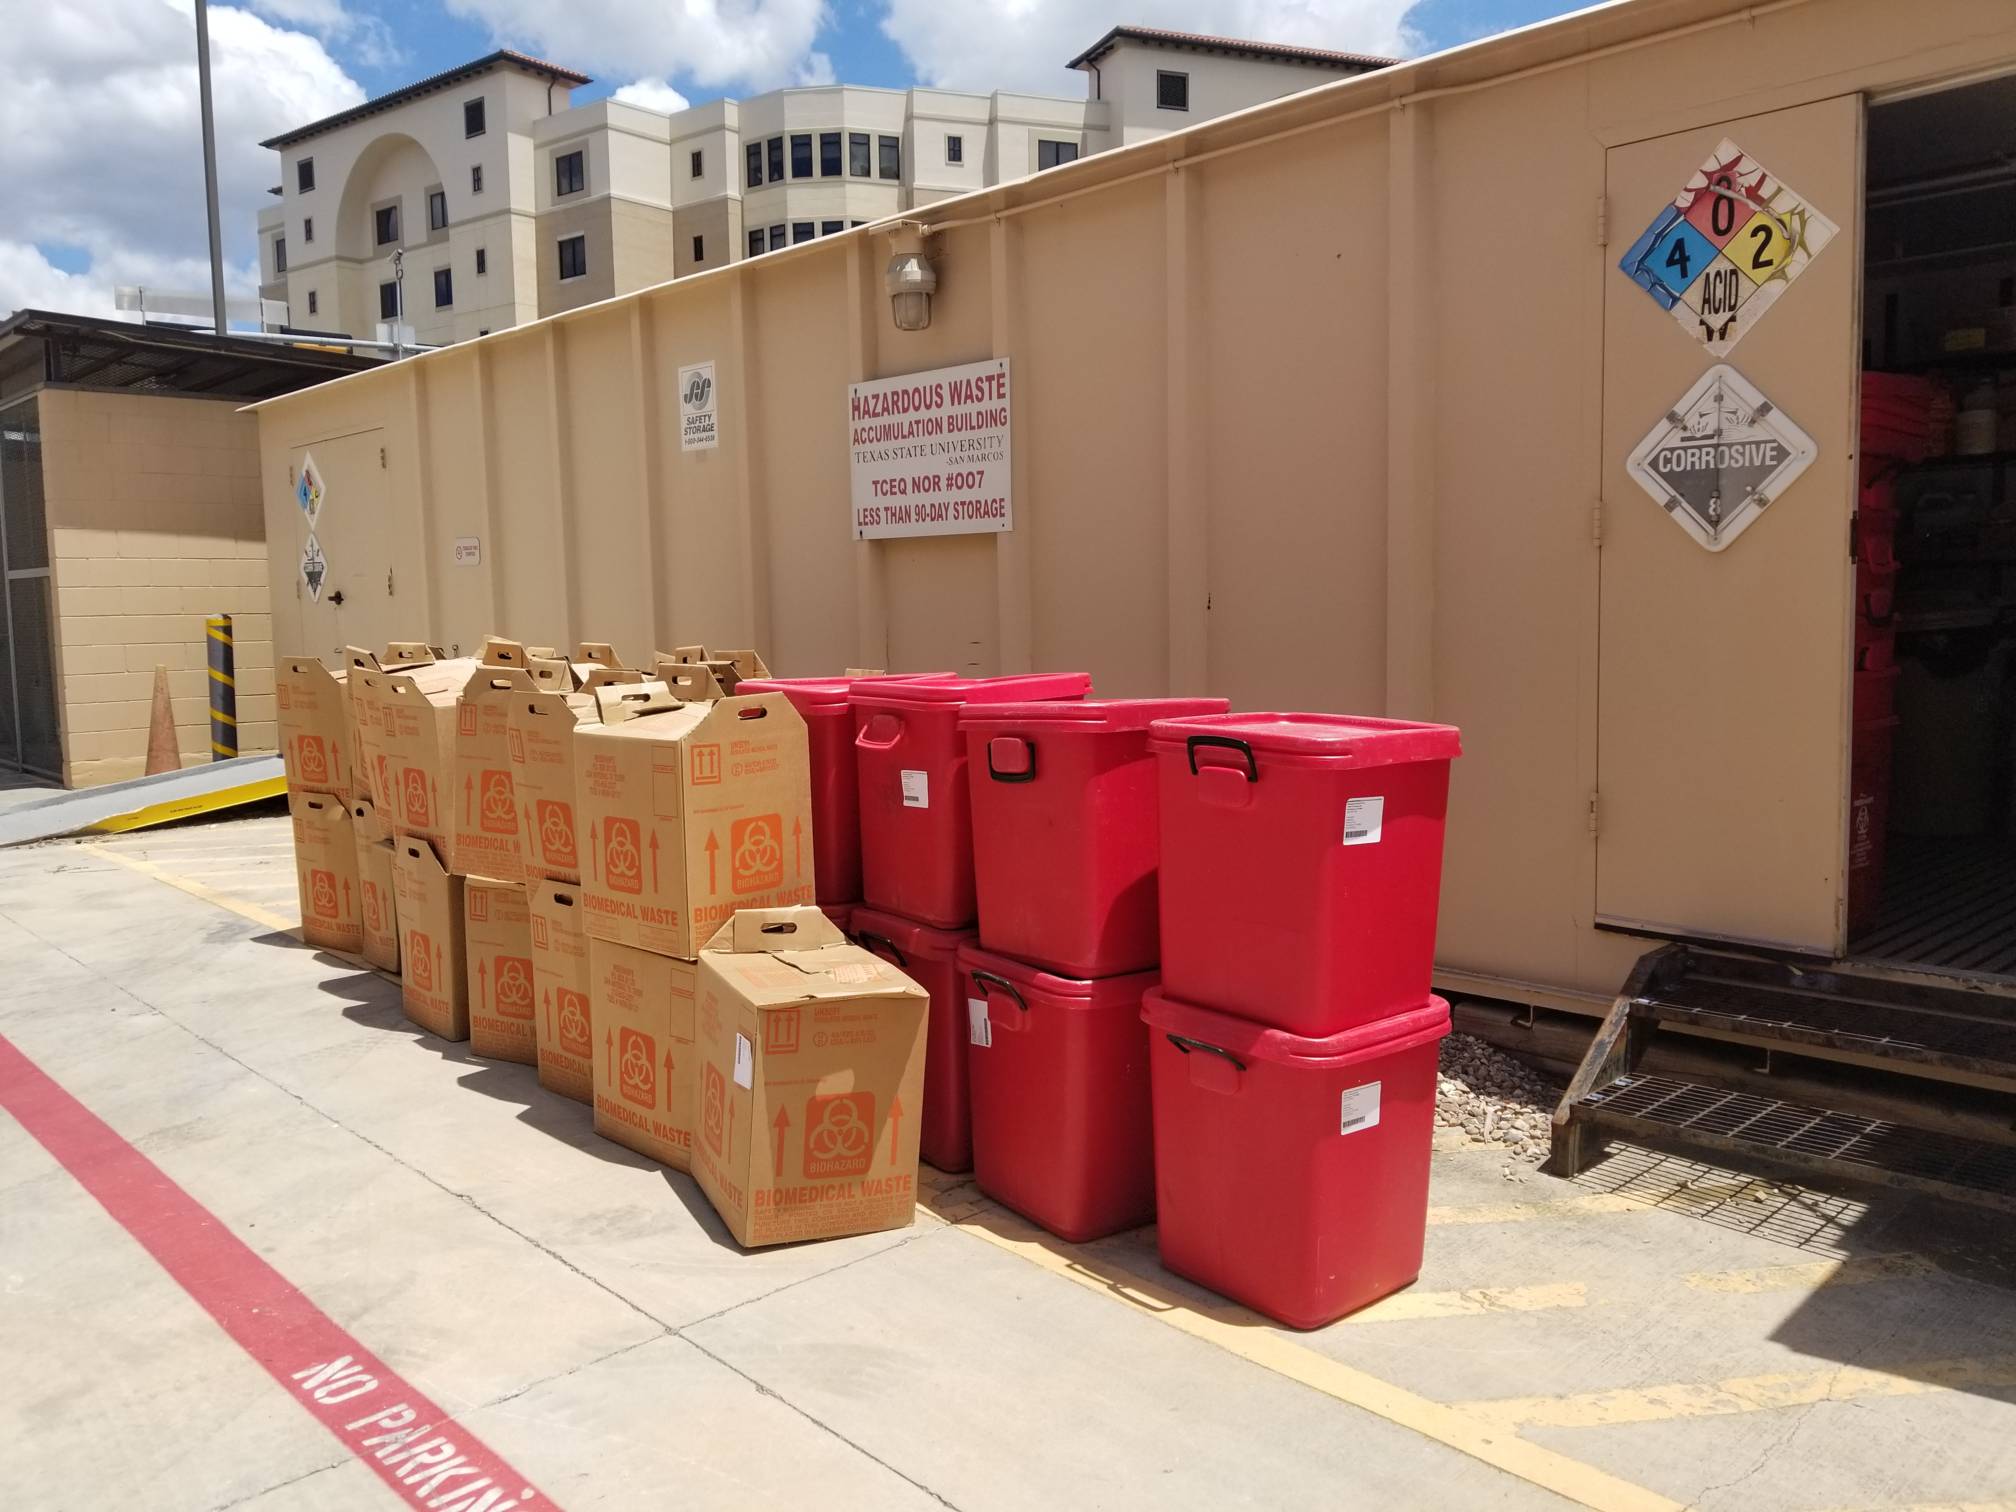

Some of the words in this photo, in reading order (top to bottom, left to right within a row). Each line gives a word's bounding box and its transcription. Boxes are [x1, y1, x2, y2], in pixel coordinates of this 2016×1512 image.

[1666, 237, 1691, 279] 4
[1750, 224, 1774, 270] 2
[1701, 268, 1740, 316] ACID
[851, 382, 944, 421] HAZARDOUS
[948, 372, 1007, 407] WASTE
[684, 422, 715, 436] STORAGE
[686, 413, 713, 426] SAFETY
[852, 416, 943, 446] ACCUMULATION
[947, 406, 1008, 434] BUILDING
[855, 449, 891, 464] TEXAS
[892, 444, 927, 461] STATE
[930, 434, 1004, 457] UNIVERSITY
[965, 450, 1004, 465] MARCOS
[1658, 442, 1778, 473] CORROSIVE
[872, 477, 907, 497] TCEQ
[911, 475, 942, 494] NOR
[946, 470, 985, 491] #007
[857, 507, 881, 527] LESS
[884, 504, 911, 525] THAN
[915, 502, 950, 523] 90-DAY
[953, 497, 1005, 521] STORAGE
[455, 832, 511, 853] BIOMEDICAL
[608, 873, 639, 890] BIOHAZARD
[737, 872, 780, 889] BIOHAZARD
[776, 884, 813, 907] WASTE
[583, 892, 638, 919] BIOMEDICAL
[640, 905, 679, 928] WASTE
[472, 1015, 527, 1037] BIOMEDICAL
[597, 1094, 650, 1132] BIOMEDICAL
[652, 1119, 691, 1148] WASTE
[809, 1158, 867, 1173] BIOHAZARD
[754, 1180, 855, 1207] BIOMEDICAL
[861, 1173, 912, 1197] WASTE
[291, 1354, 379, 1405] NO
[345, 1403, 535, 1512] PARKIN
